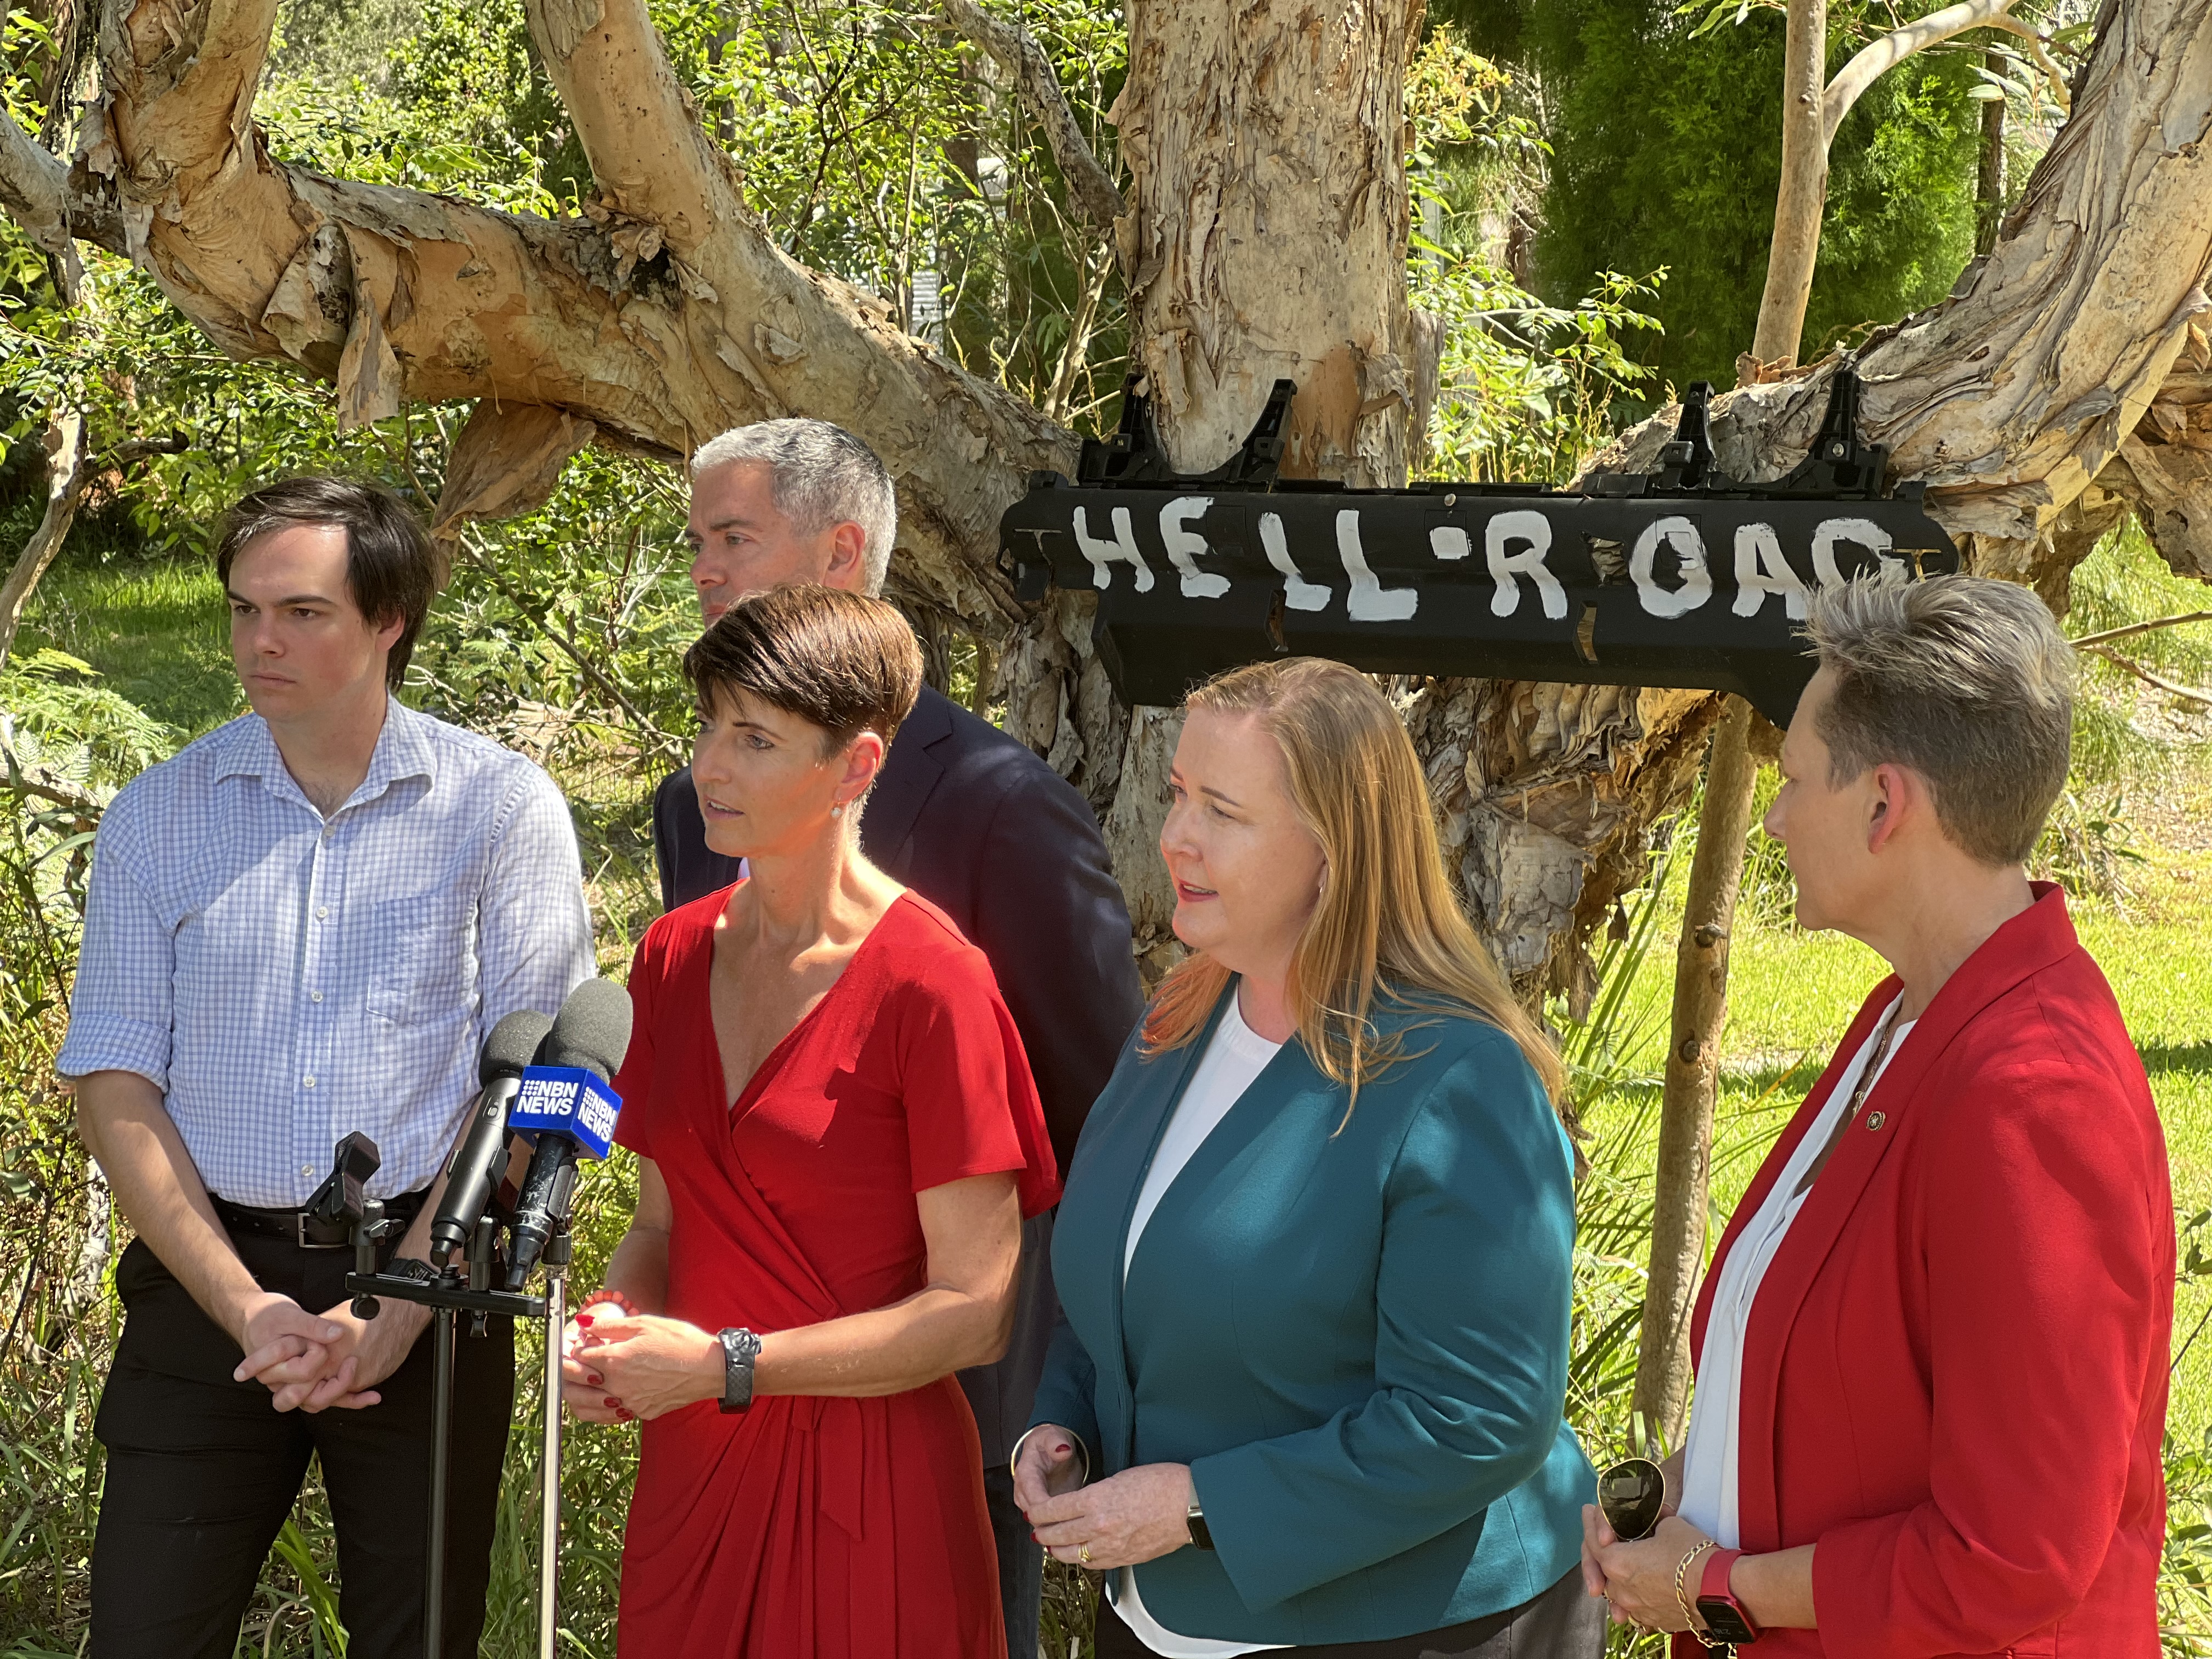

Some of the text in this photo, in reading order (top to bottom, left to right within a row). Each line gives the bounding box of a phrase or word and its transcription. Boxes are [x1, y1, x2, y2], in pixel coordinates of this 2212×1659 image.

[1073, 496, 1419, 622] HELL
[537, 1080, 579, 1098] NBN
[516, 1096, 574, 1115] NEWS
[591, 1097, 617, 1126] NBN
[578, 1102, 612, 1142] NEWS
